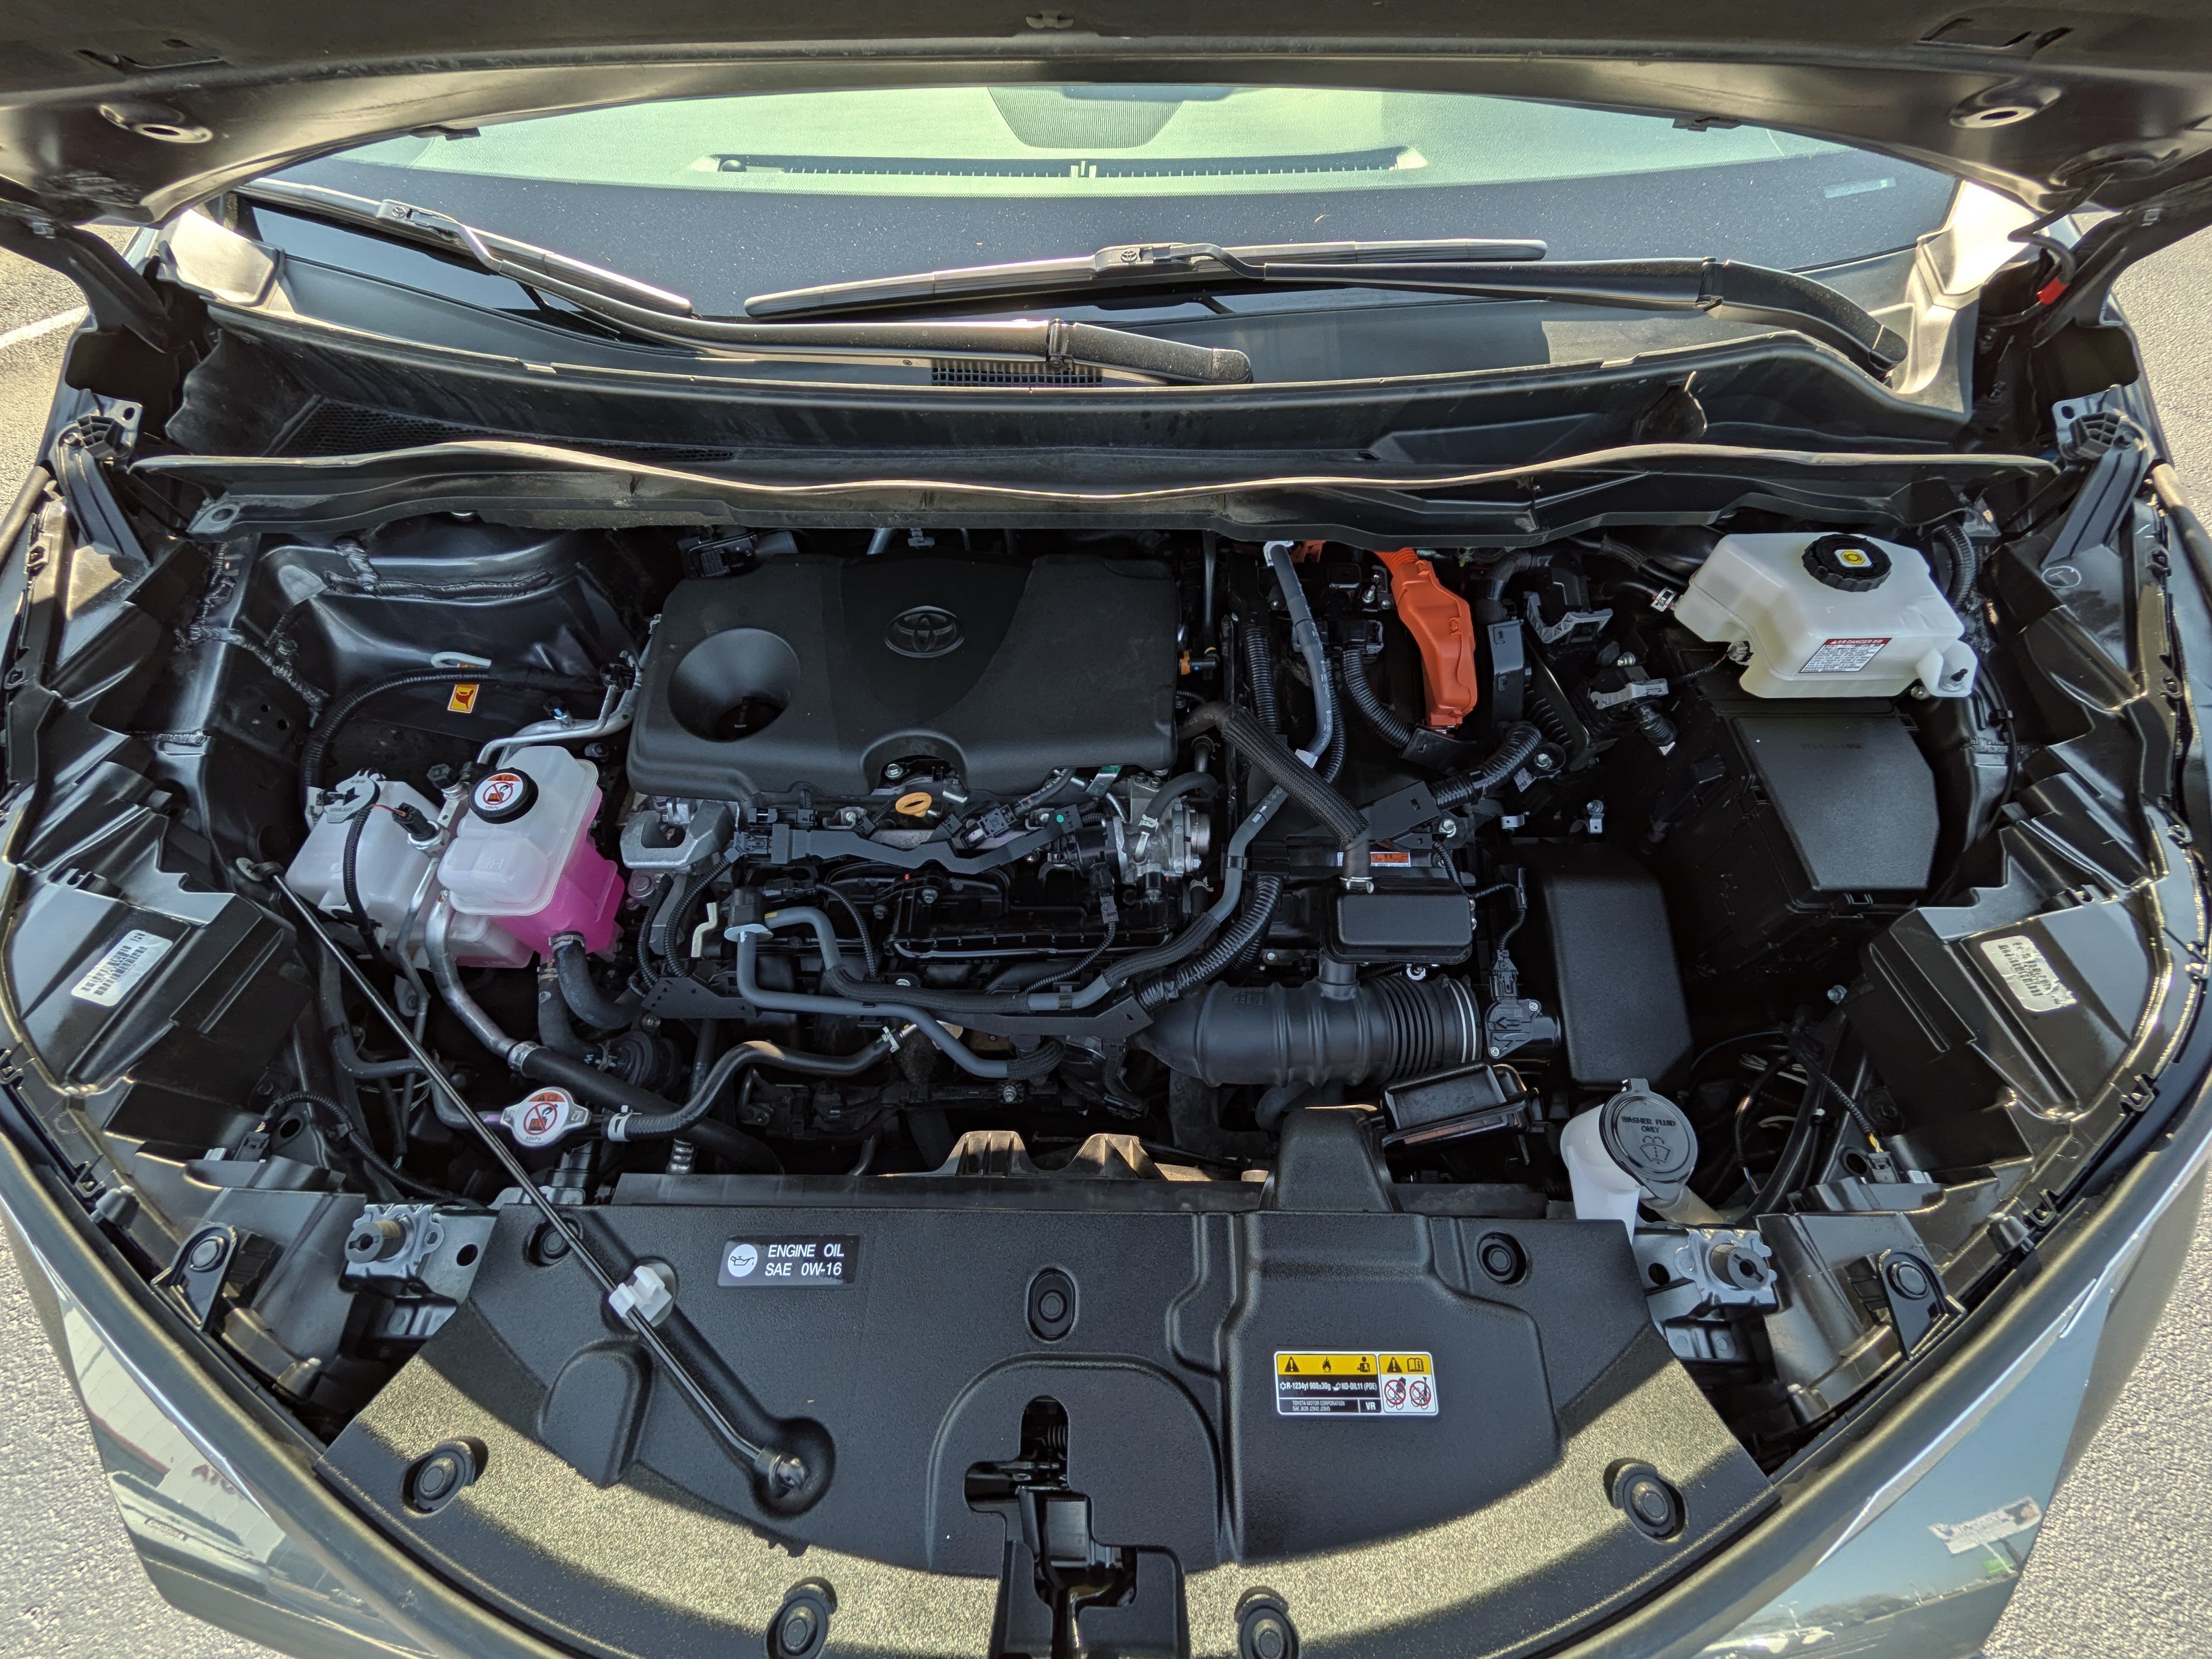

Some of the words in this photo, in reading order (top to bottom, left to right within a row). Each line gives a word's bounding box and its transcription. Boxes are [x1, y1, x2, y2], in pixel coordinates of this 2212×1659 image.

[1621, 1116, 1652, 1125] WASHER
[768, 1244, 816, 1258] ENGINE
[823, 1244, 844, 1257] OIL
[765, 1262, 792, 1276] SAE
[801, 1262, 842, 1276] 0W-16
[1286, 1382, 1308, 1391] R-1234yf
[1364, 1382, 1378, 1391] (POE)
[1365, 1401, 1376, 1410] VR
